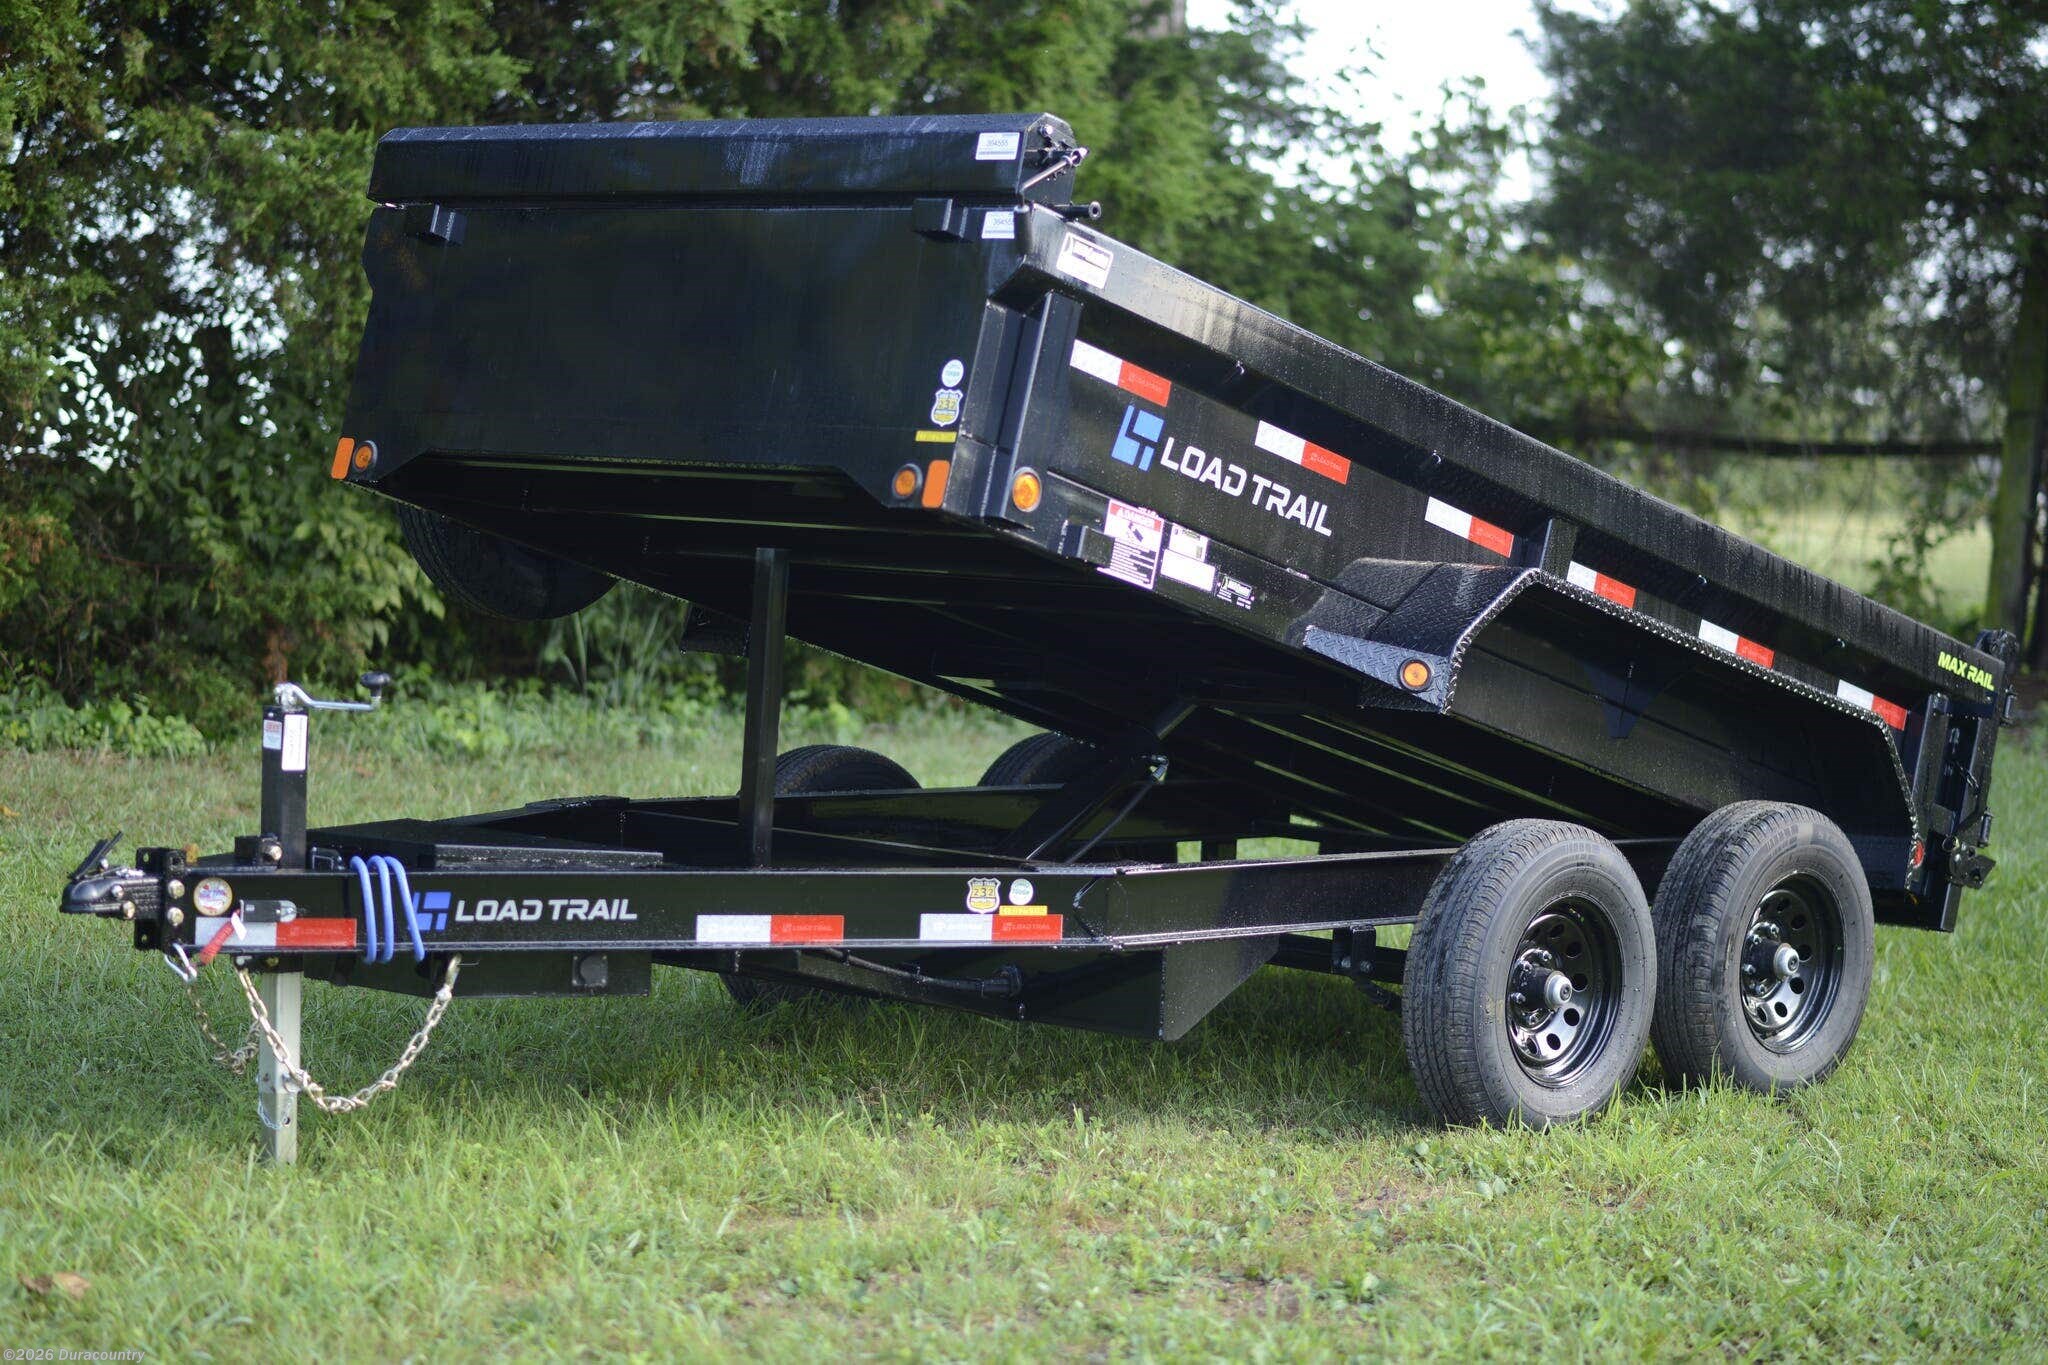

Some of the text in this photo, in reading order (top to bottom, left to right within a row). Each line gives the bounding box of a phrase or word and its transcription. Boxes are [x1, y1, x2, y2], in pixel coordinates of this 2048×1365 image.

[1160, 437, 1332, 537] LOAD TRAIL
[1938, 651, 1994, 691] MAX RAIL
[973, 887, 994, 897] 232
[455, 899, 638, 922] LOAD TRAIL
